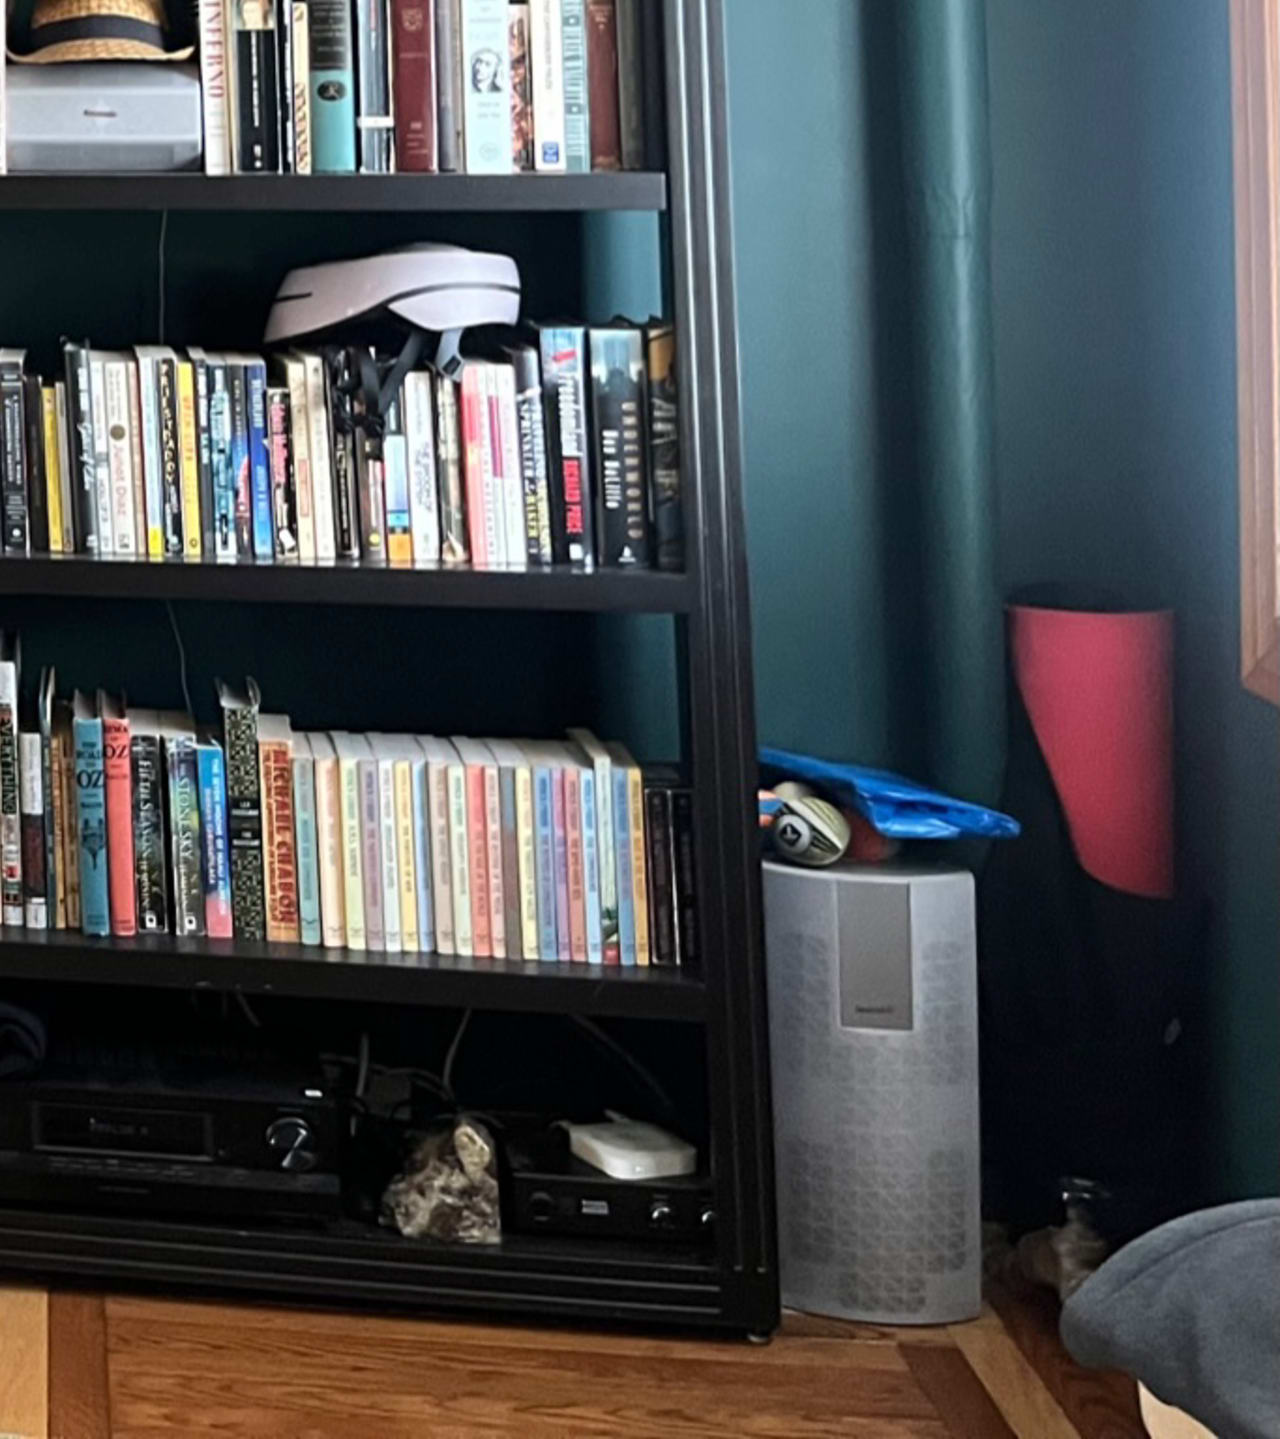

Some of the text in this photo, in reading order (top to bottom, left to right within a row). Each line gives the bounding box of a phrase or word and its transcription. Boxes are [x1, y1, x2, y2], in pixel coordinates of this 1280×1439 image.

[204, 0, 225, 99] INFERNO
[520, 402, 536, 479] SPRINKLER
[563, 460, 581, 503] RICHARD
[602, 429, 622, 509] Don DeLillo
[622, 401, 643, 539] UNDERWORLD
[566, 504, 583, 534] PRICE
[104, 743, 130, 761] OZ
[76, 769, 105, 789] OZ
[177, 777, 192, 827] STONE
[214, 804, 222, 836] MOONS
[273, 749, 297, 925] MICHAEL CHABON
[180, 830, 193, 862] SKY
